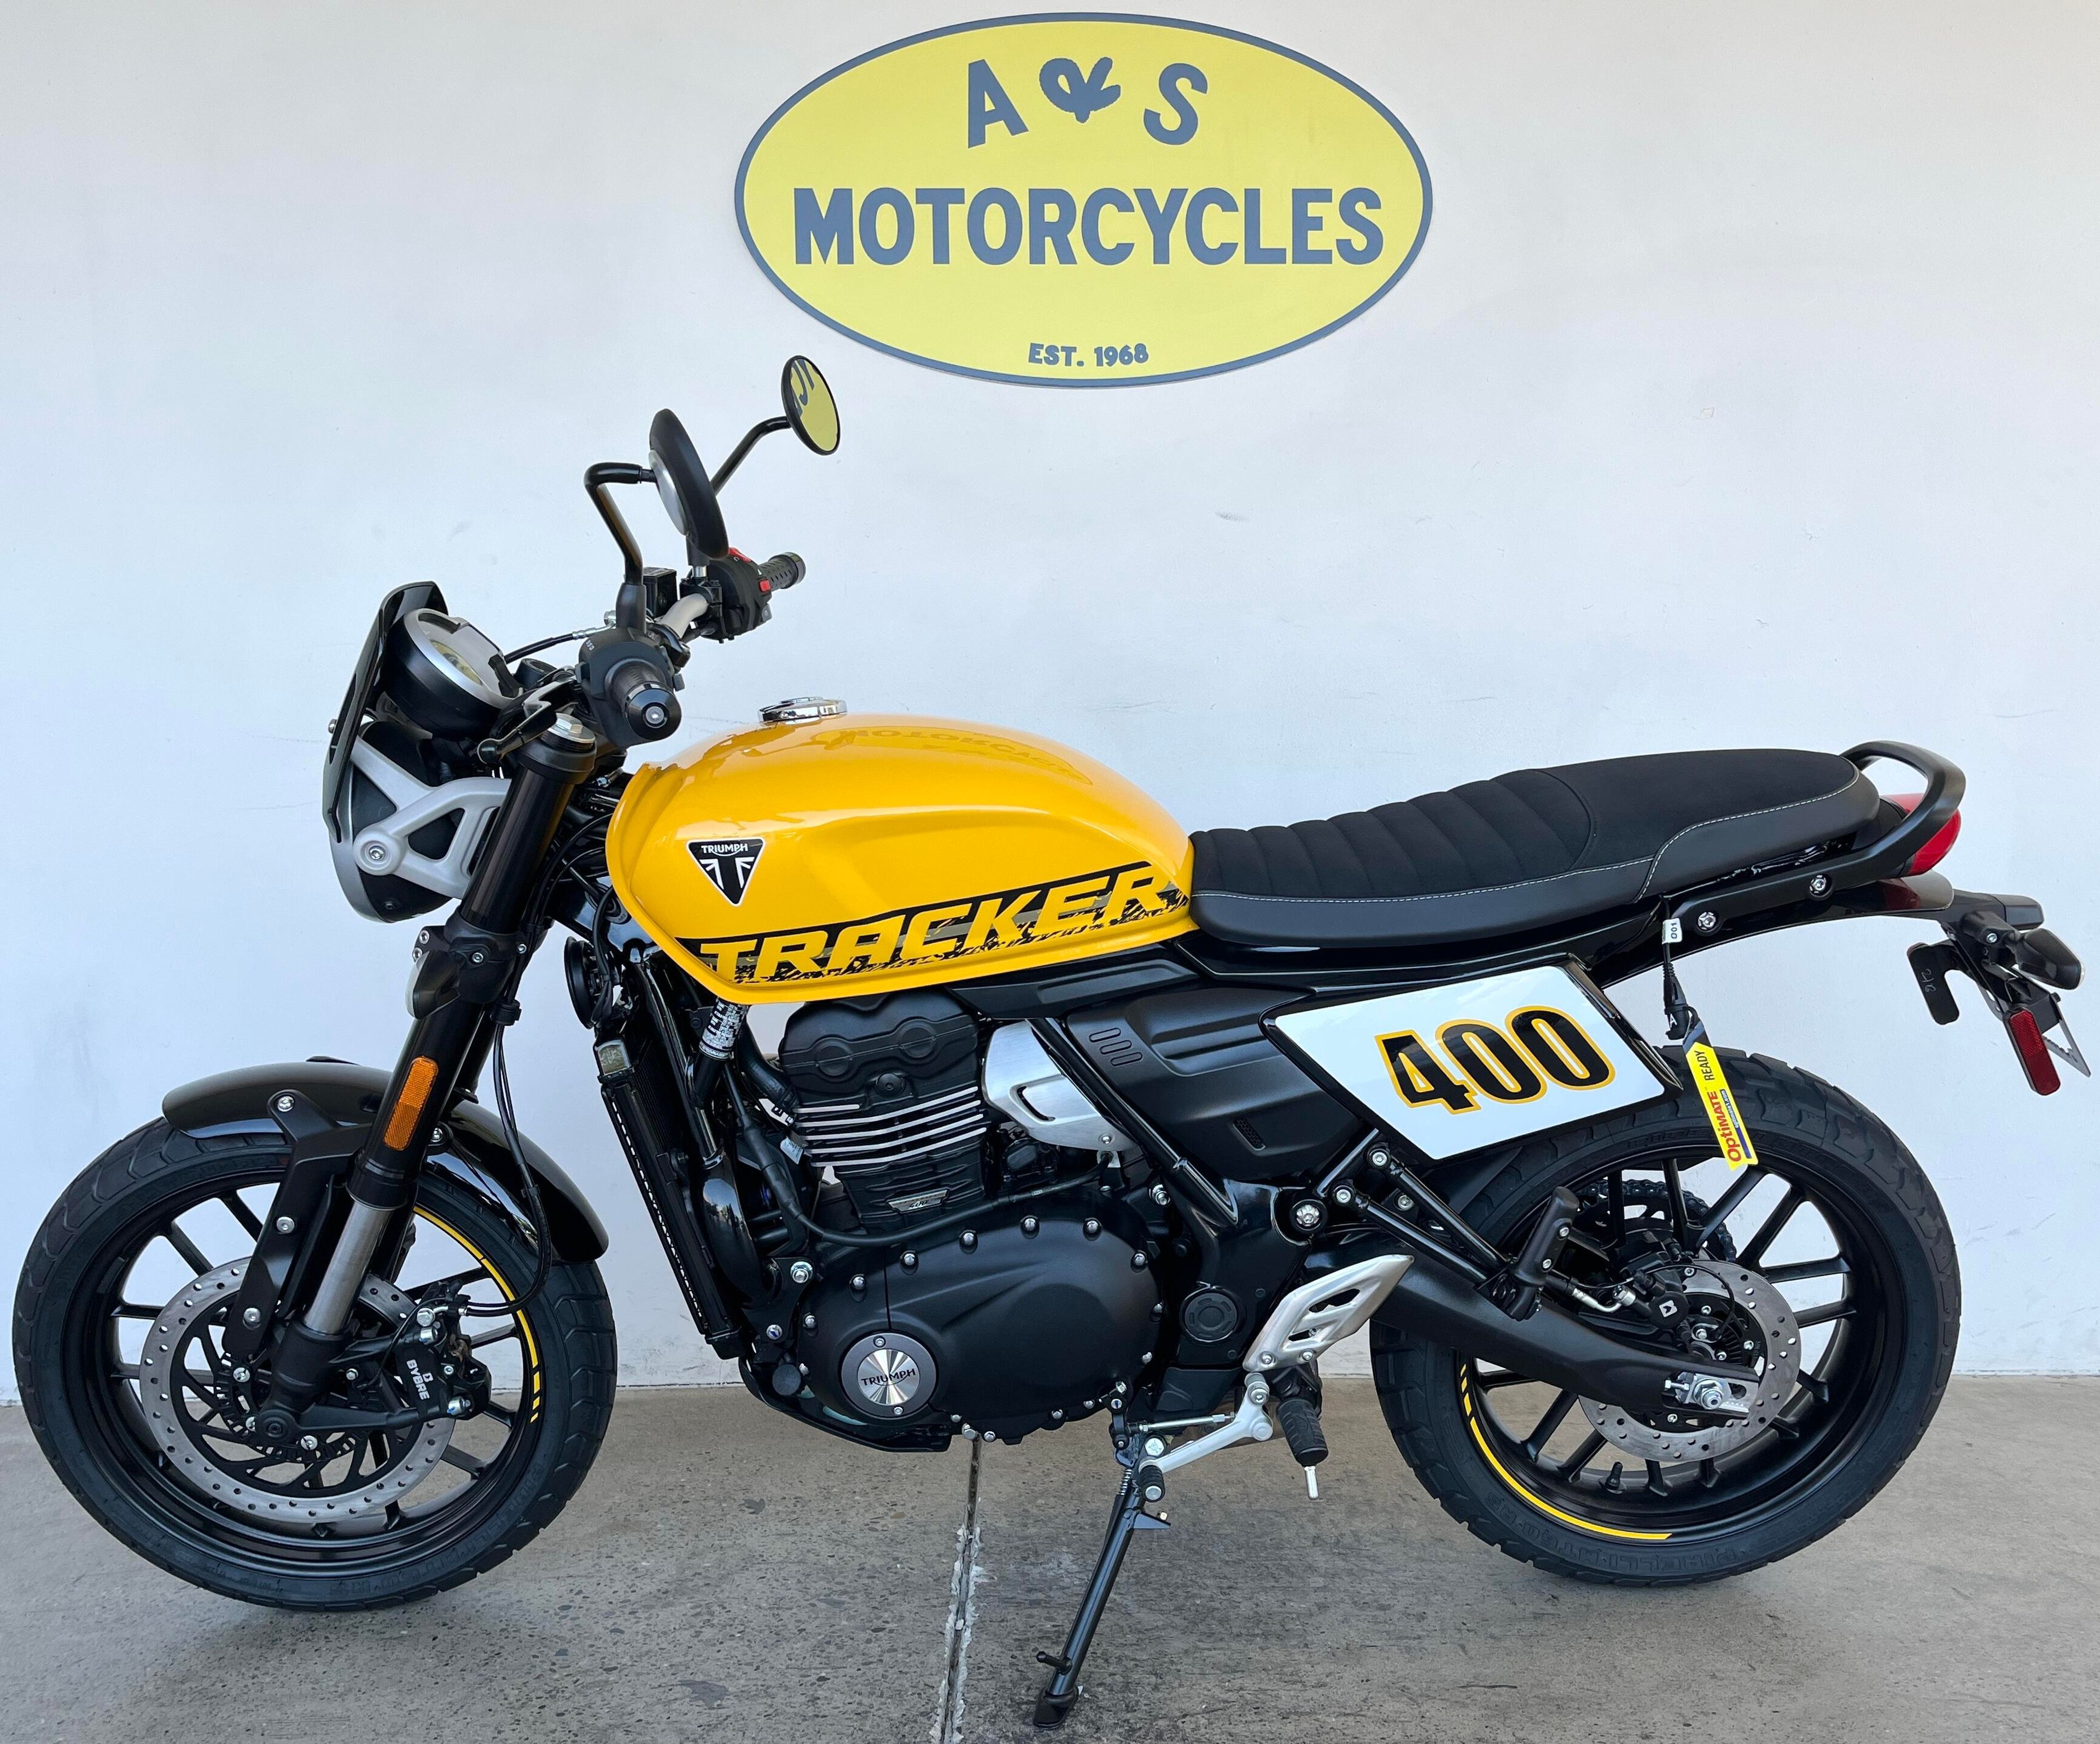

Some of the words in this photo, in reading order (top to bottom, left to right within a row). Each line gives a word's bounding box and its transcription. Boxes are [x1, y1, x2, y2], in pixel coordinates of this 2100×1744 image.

[969, 61, 1028, 148] A
[1144, 63, 1208, 145] S
[794, 188, 1384, 265] MOTORCYCLES
[1029, 343, 1084, 366] EST.
[1094, 343, 1149, 366] 1968
[701, 843, 748, 856] TRIUMPH
[701, 864, 1168, 982] TRACKER
[1374, 1006, 1615, 1115] 400
[1694, 1050, 1715, 1081] READY
[406, 1360, 430, 1400] BYBRE
[861, 1369, 916, 1386] TRIUMPH
